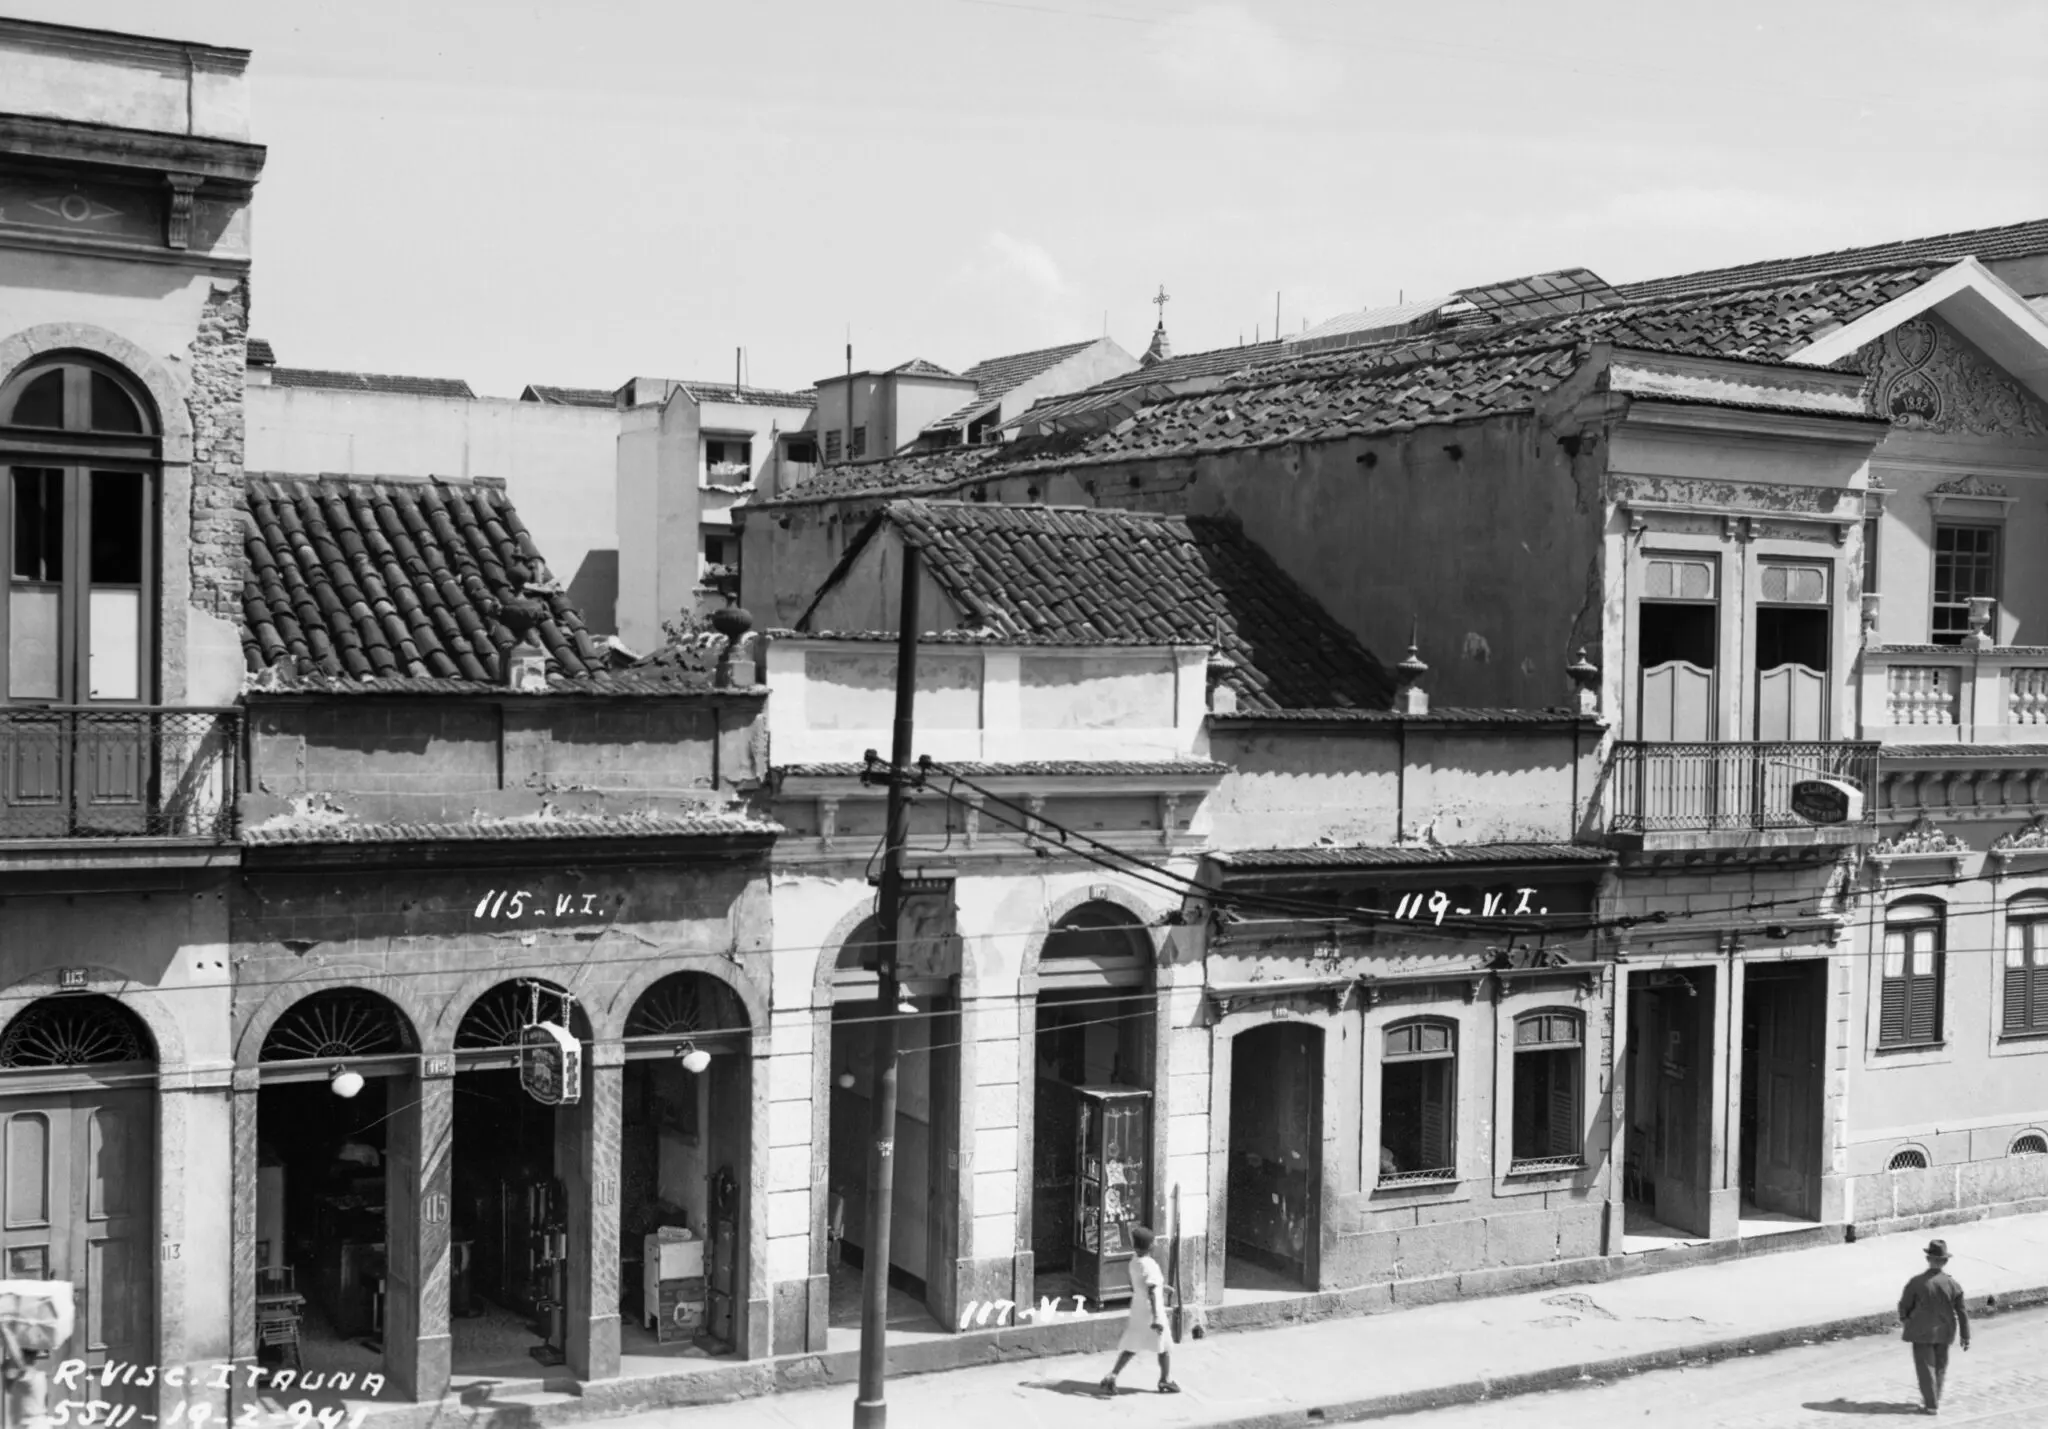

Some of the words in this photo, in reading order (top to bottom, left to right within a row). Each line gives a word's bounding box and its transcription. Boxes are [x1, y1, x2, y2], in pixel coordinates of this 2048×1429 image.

[1903, 395, 1929, 412] 1882
[812, 1164, 827, 1182] 117
[426, 1192, 448, 1222] 115
[162, 1243, 181, 1260] 113
